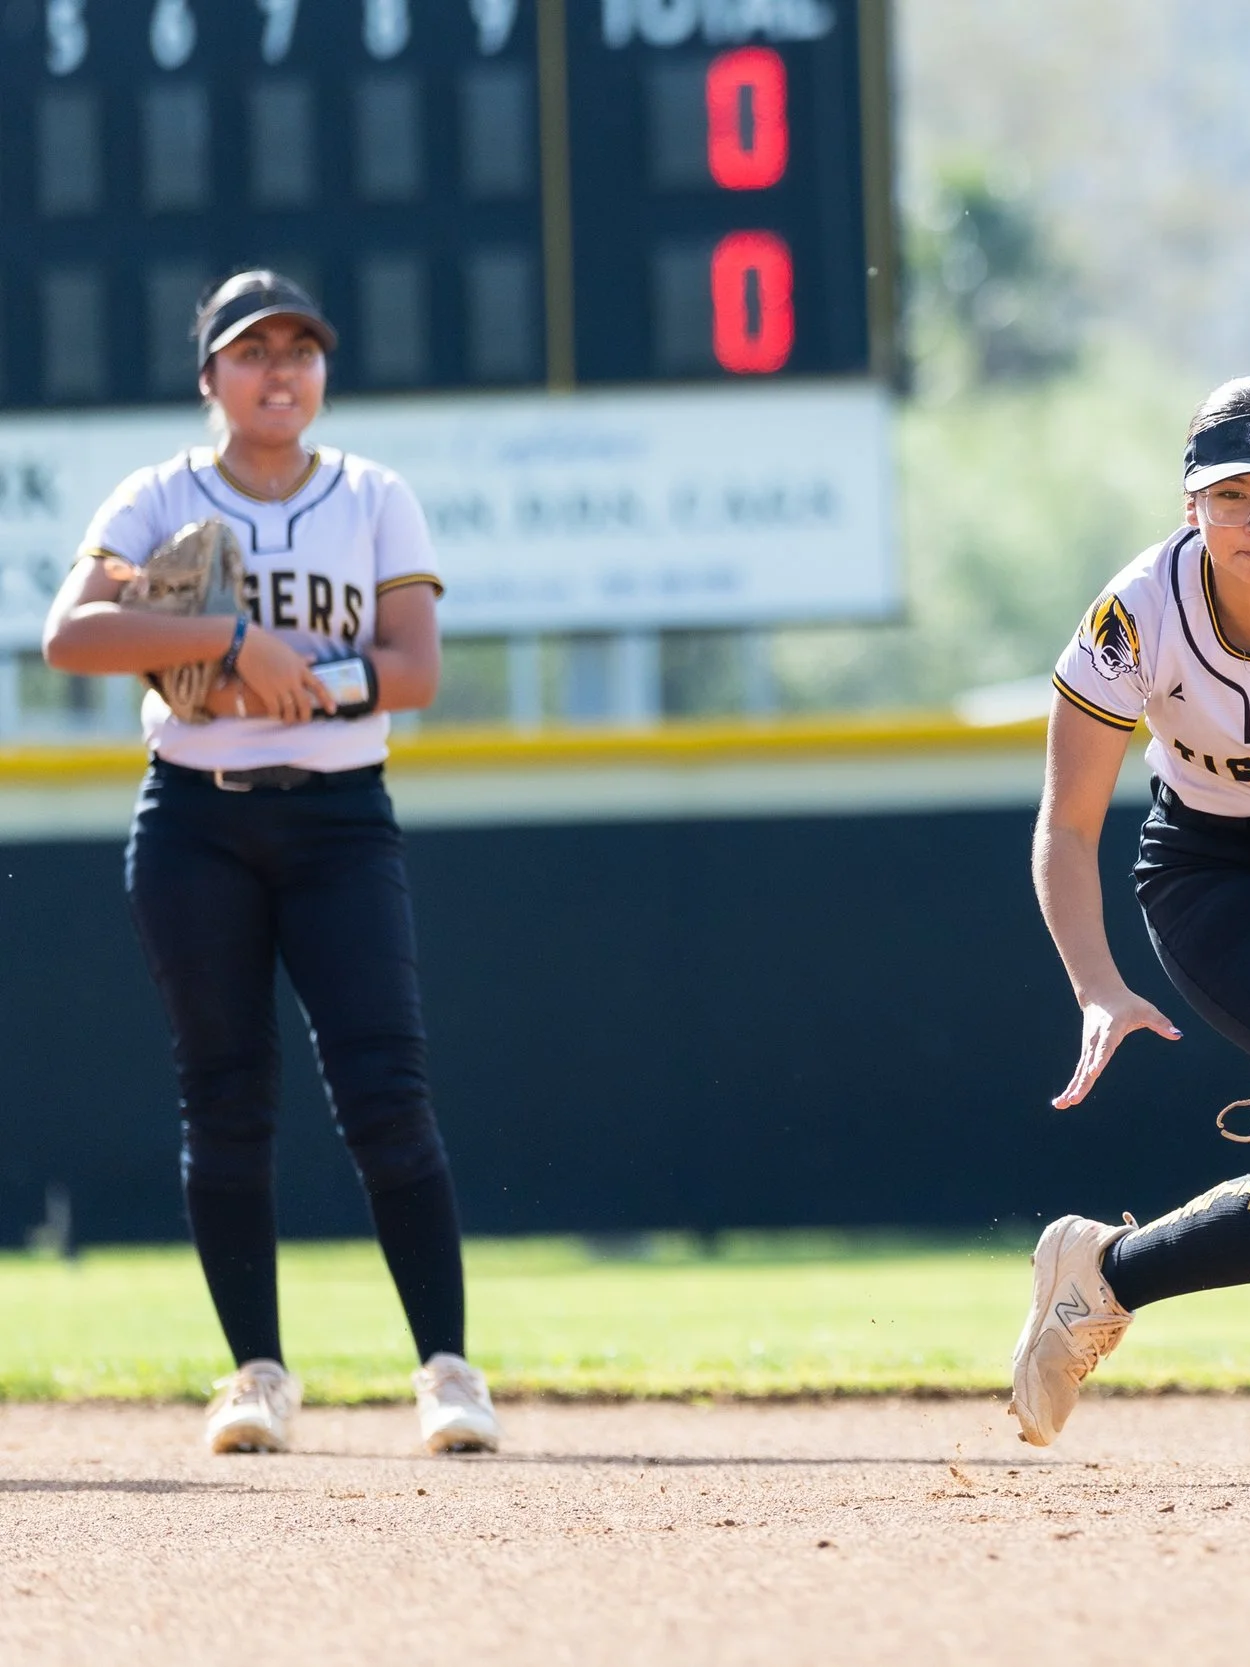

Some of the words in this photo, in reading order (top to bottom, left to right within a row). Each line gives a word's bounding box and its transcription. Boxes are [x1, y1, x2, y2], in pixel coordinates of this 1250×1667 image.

[706, 46, 790, 190] 0
[711, 230, 795, 374] 0
[244, 570, 363, 643] GERS
